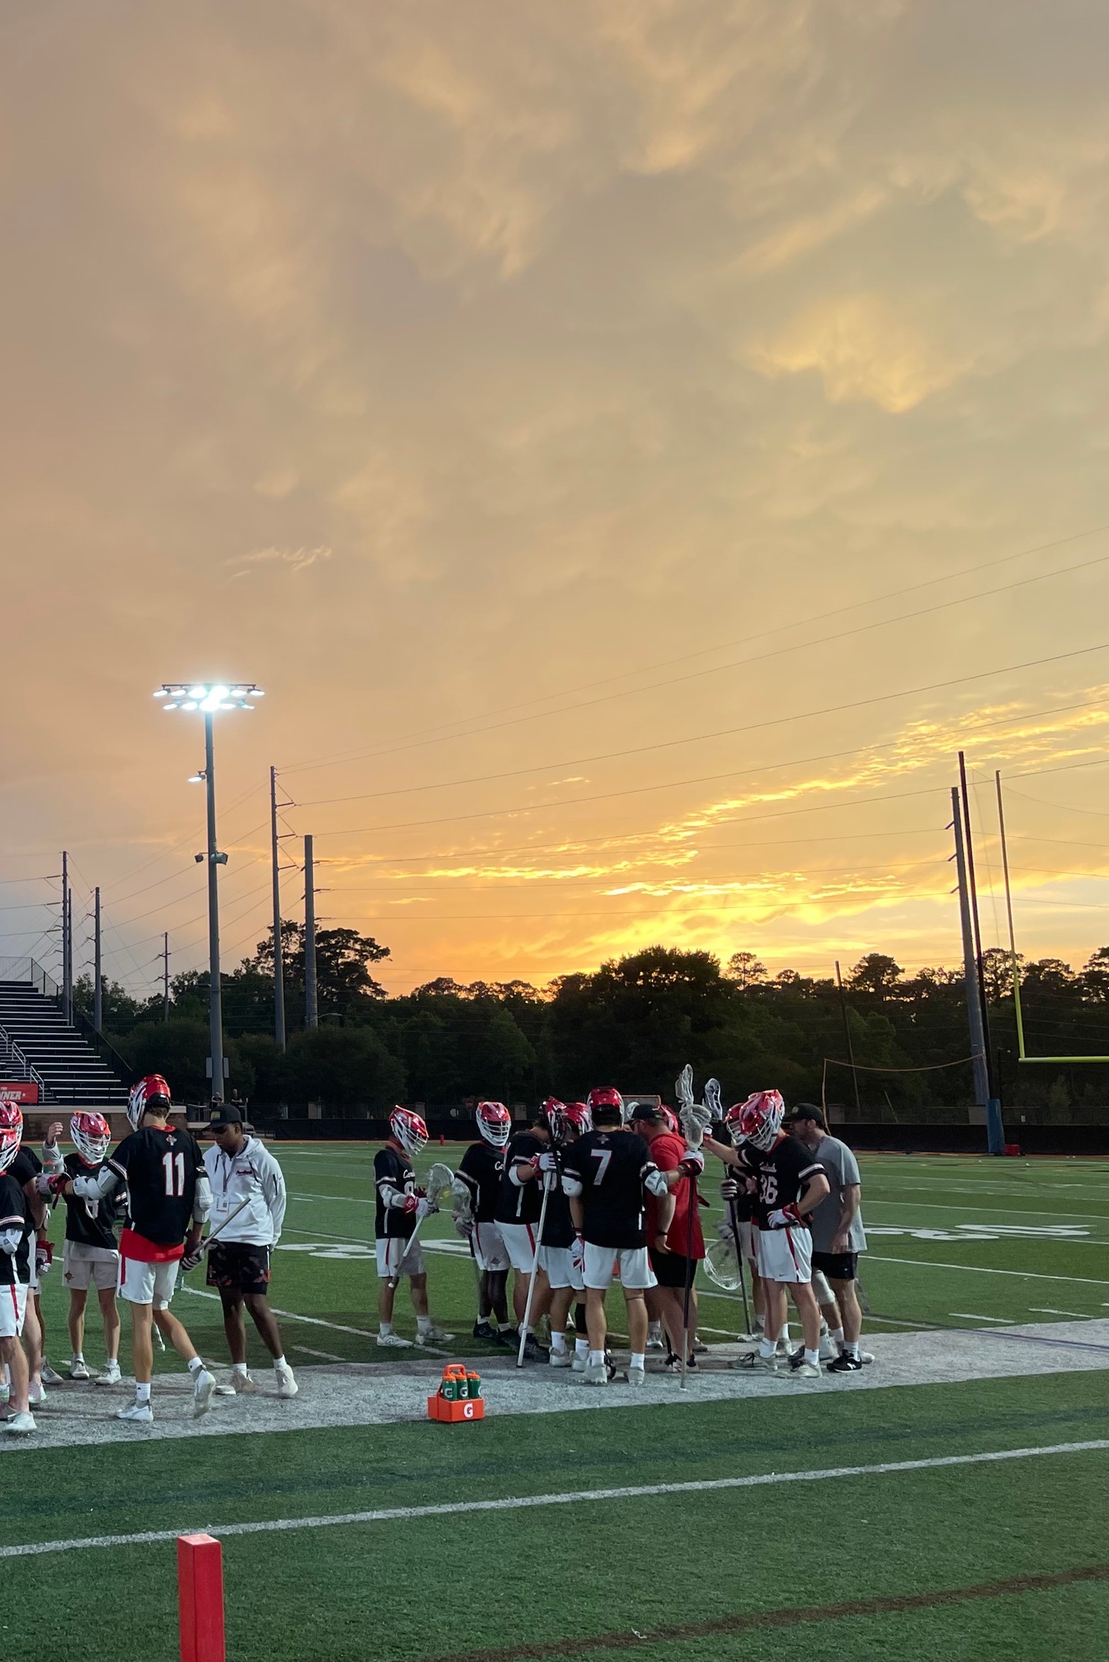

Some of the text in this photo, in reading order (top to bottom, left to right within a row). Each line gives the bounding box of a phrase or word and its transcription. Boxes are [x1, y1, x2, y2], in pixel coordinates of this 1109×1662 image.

[162, 1151, 186, 1197] 11
[590, 1149, 613, 1186] 7
[759, 1174, 779, 1205] 36
[459, 1386, 468, 1397] G
[463, 1402, 473, 1418] G
